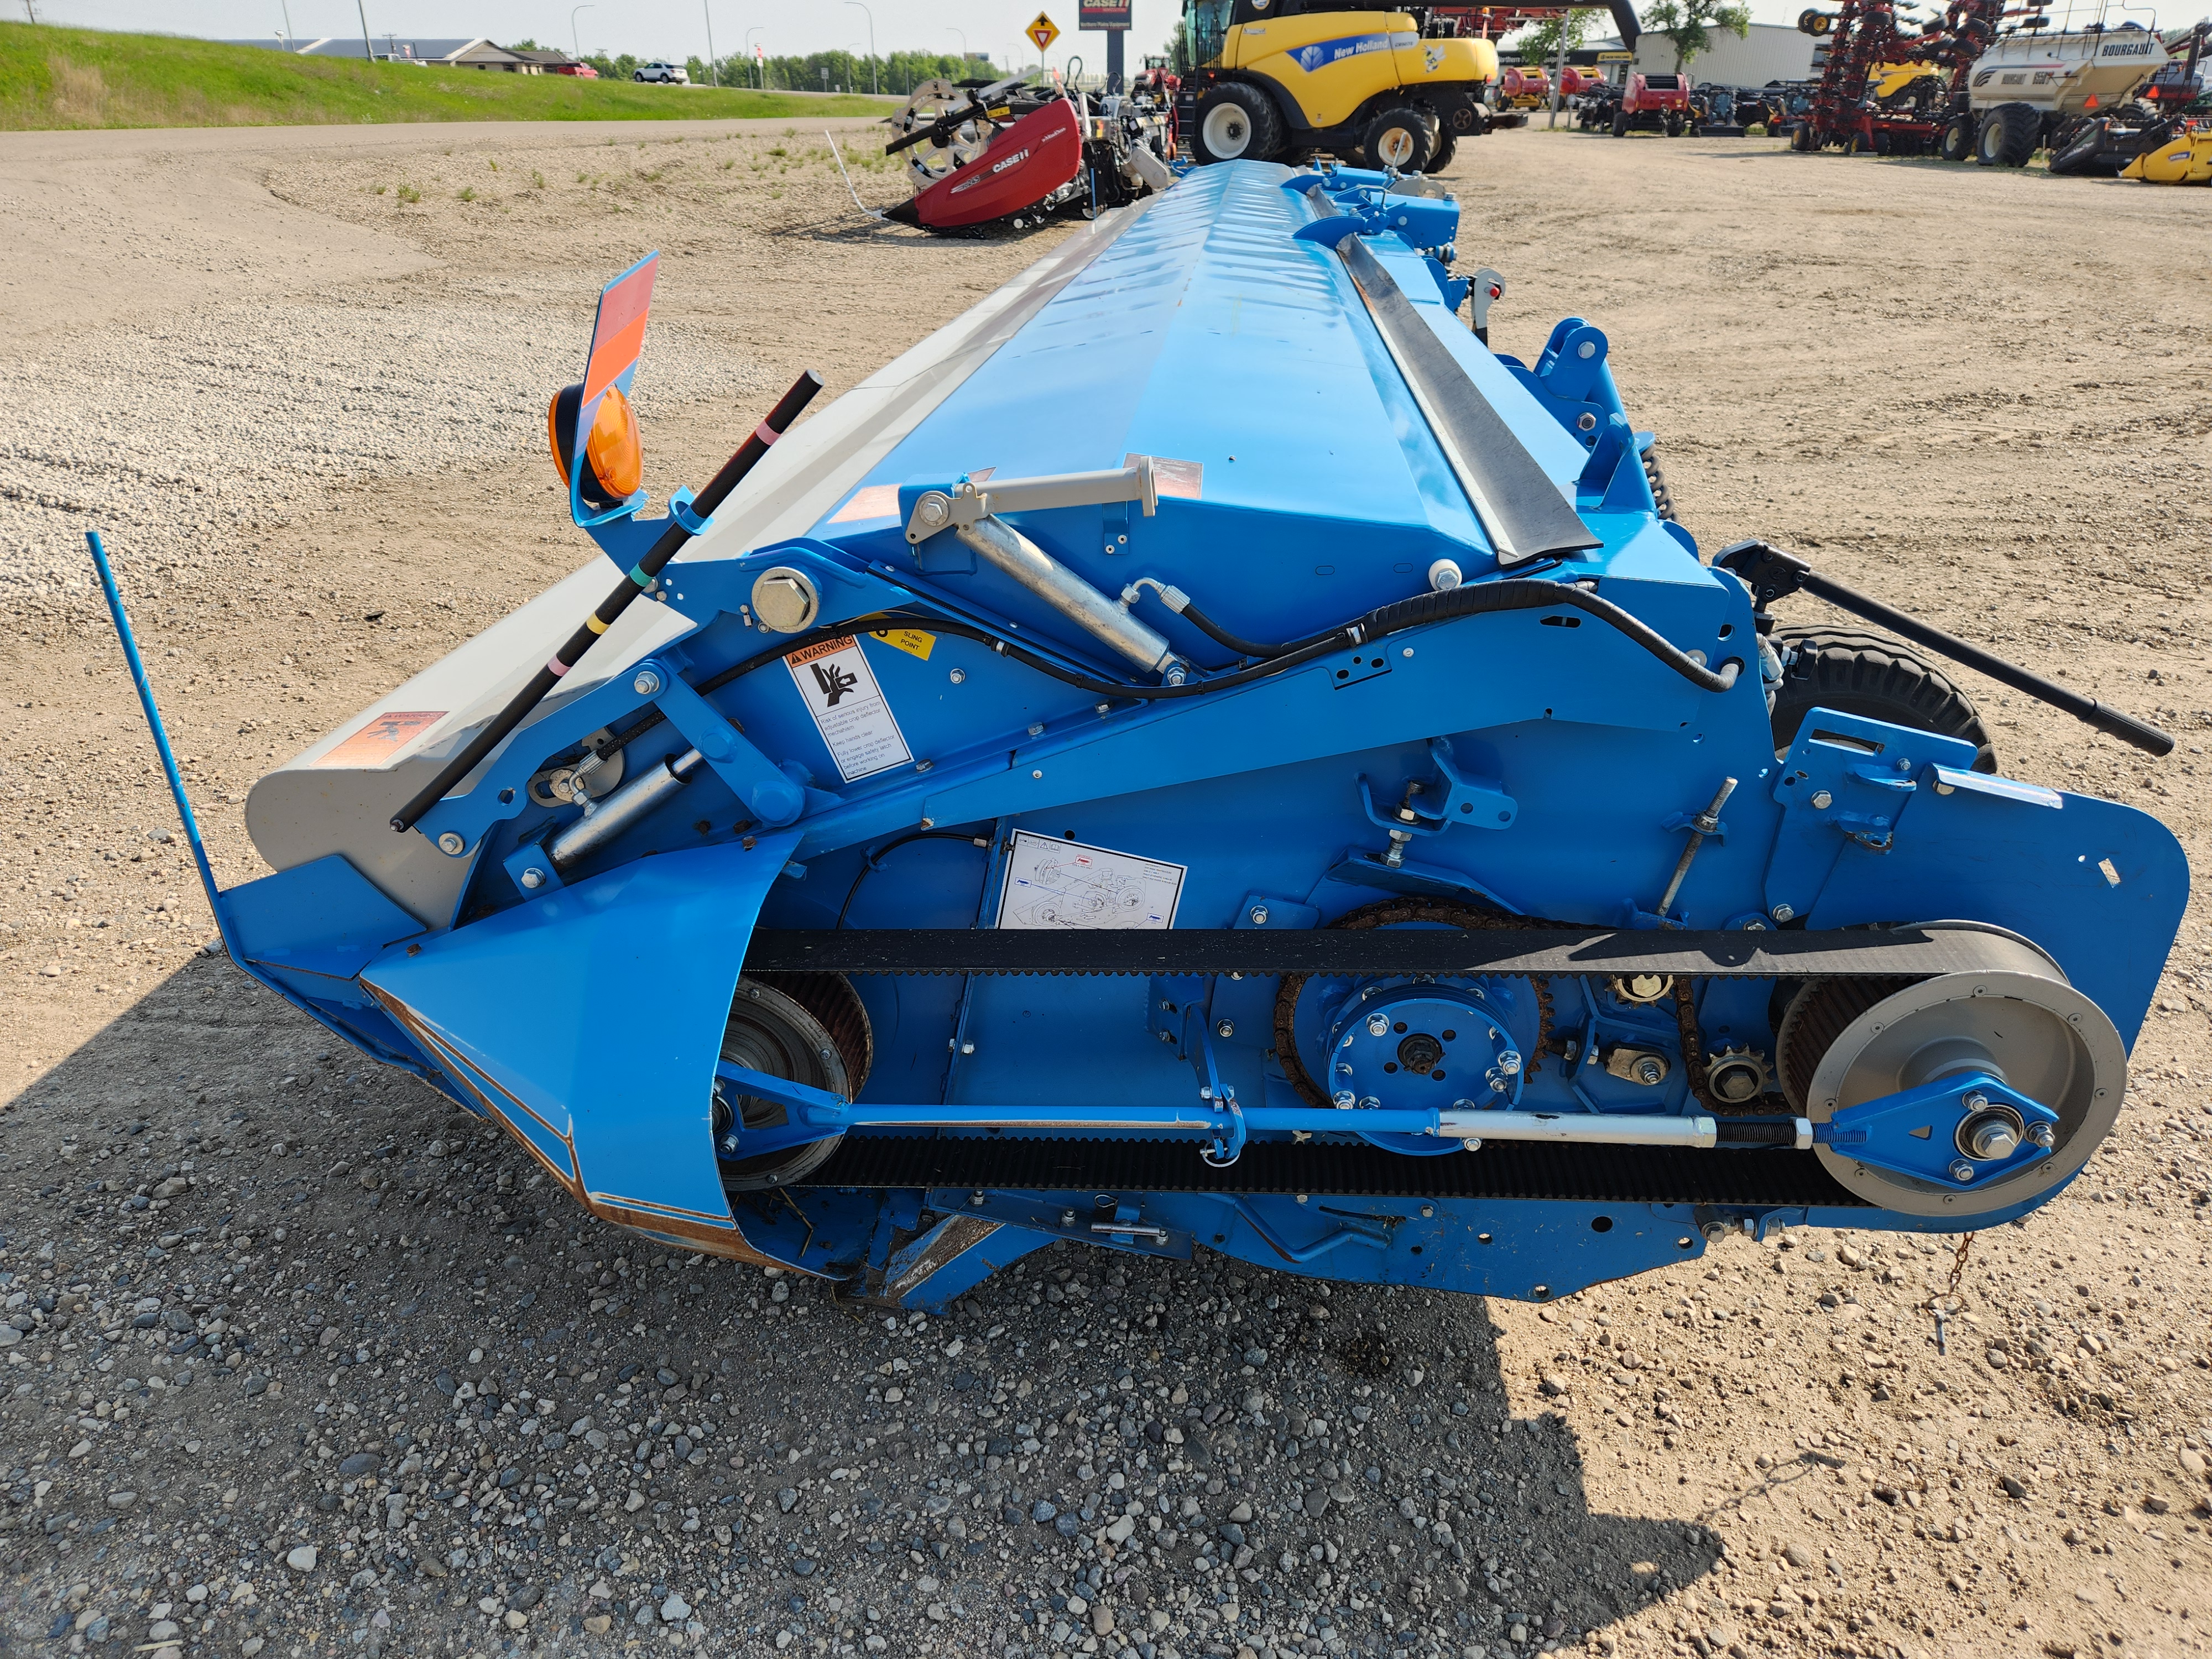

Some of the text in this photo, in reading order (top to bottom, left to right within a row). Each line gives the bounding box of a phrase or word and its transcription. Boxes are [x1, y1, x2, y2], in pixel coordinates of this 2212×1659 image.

[1334, 38, 1389, 60] New Holland
[2102, 43, 2154, 56] BOURGAUT
[993, 154, 1020, 173] CASE
[904, 631, 923, 643] SLING
[800, 636, 853, 660] WARNING
[900, 639, 920, 650] POINT
[824, 719, 848, 731] adjustable
[860, 708, 880, 718] deflector
[838, 709, 855, 718] serious
[827, 725, 854, 737] mechanism
[874, 734, 895, 744] deflector
[843, 761, 859, 770] before
[859, 755, 878, 764] working
[846, 753, 864, 761] engage
[847, 766, 867, 776] machine
